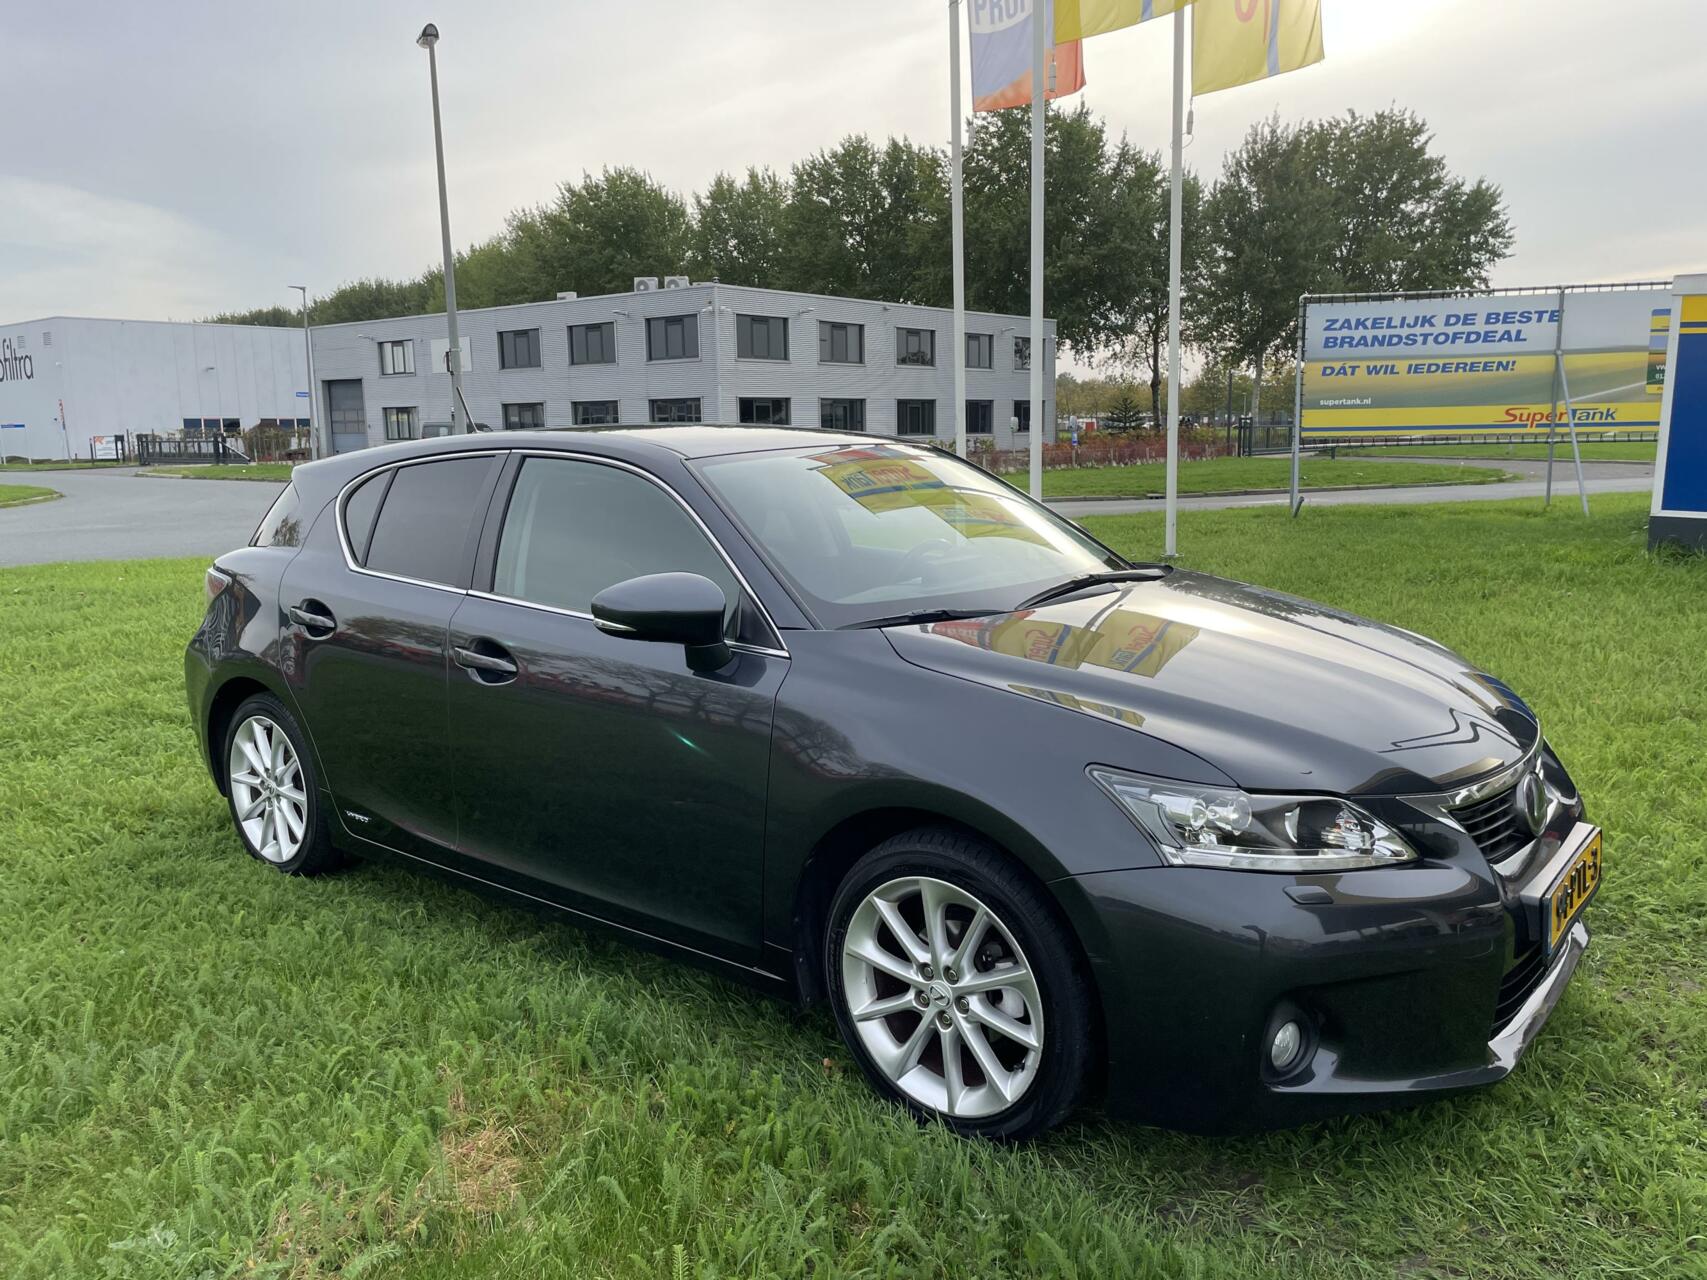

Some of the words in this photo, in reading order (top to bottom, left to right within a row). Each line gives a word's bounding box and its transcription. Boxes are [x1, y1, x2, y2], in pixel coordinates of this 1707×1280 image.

[1323, 314, 1437, 331] ZAKELIJK
[1443, 312, 1477, 327] DE
[1484, 309, 1561, 325] BESTE
[1323, 329, 1528, 349] BRANDSTOFDEAL
[1321, 362, 1360, 377] DÁT
[1366, 363, 1400, 376] WIL
[1406, 360, 1517, 375] IEDEREEN!
[1319, 397, 1372, 406] supertank.nl
